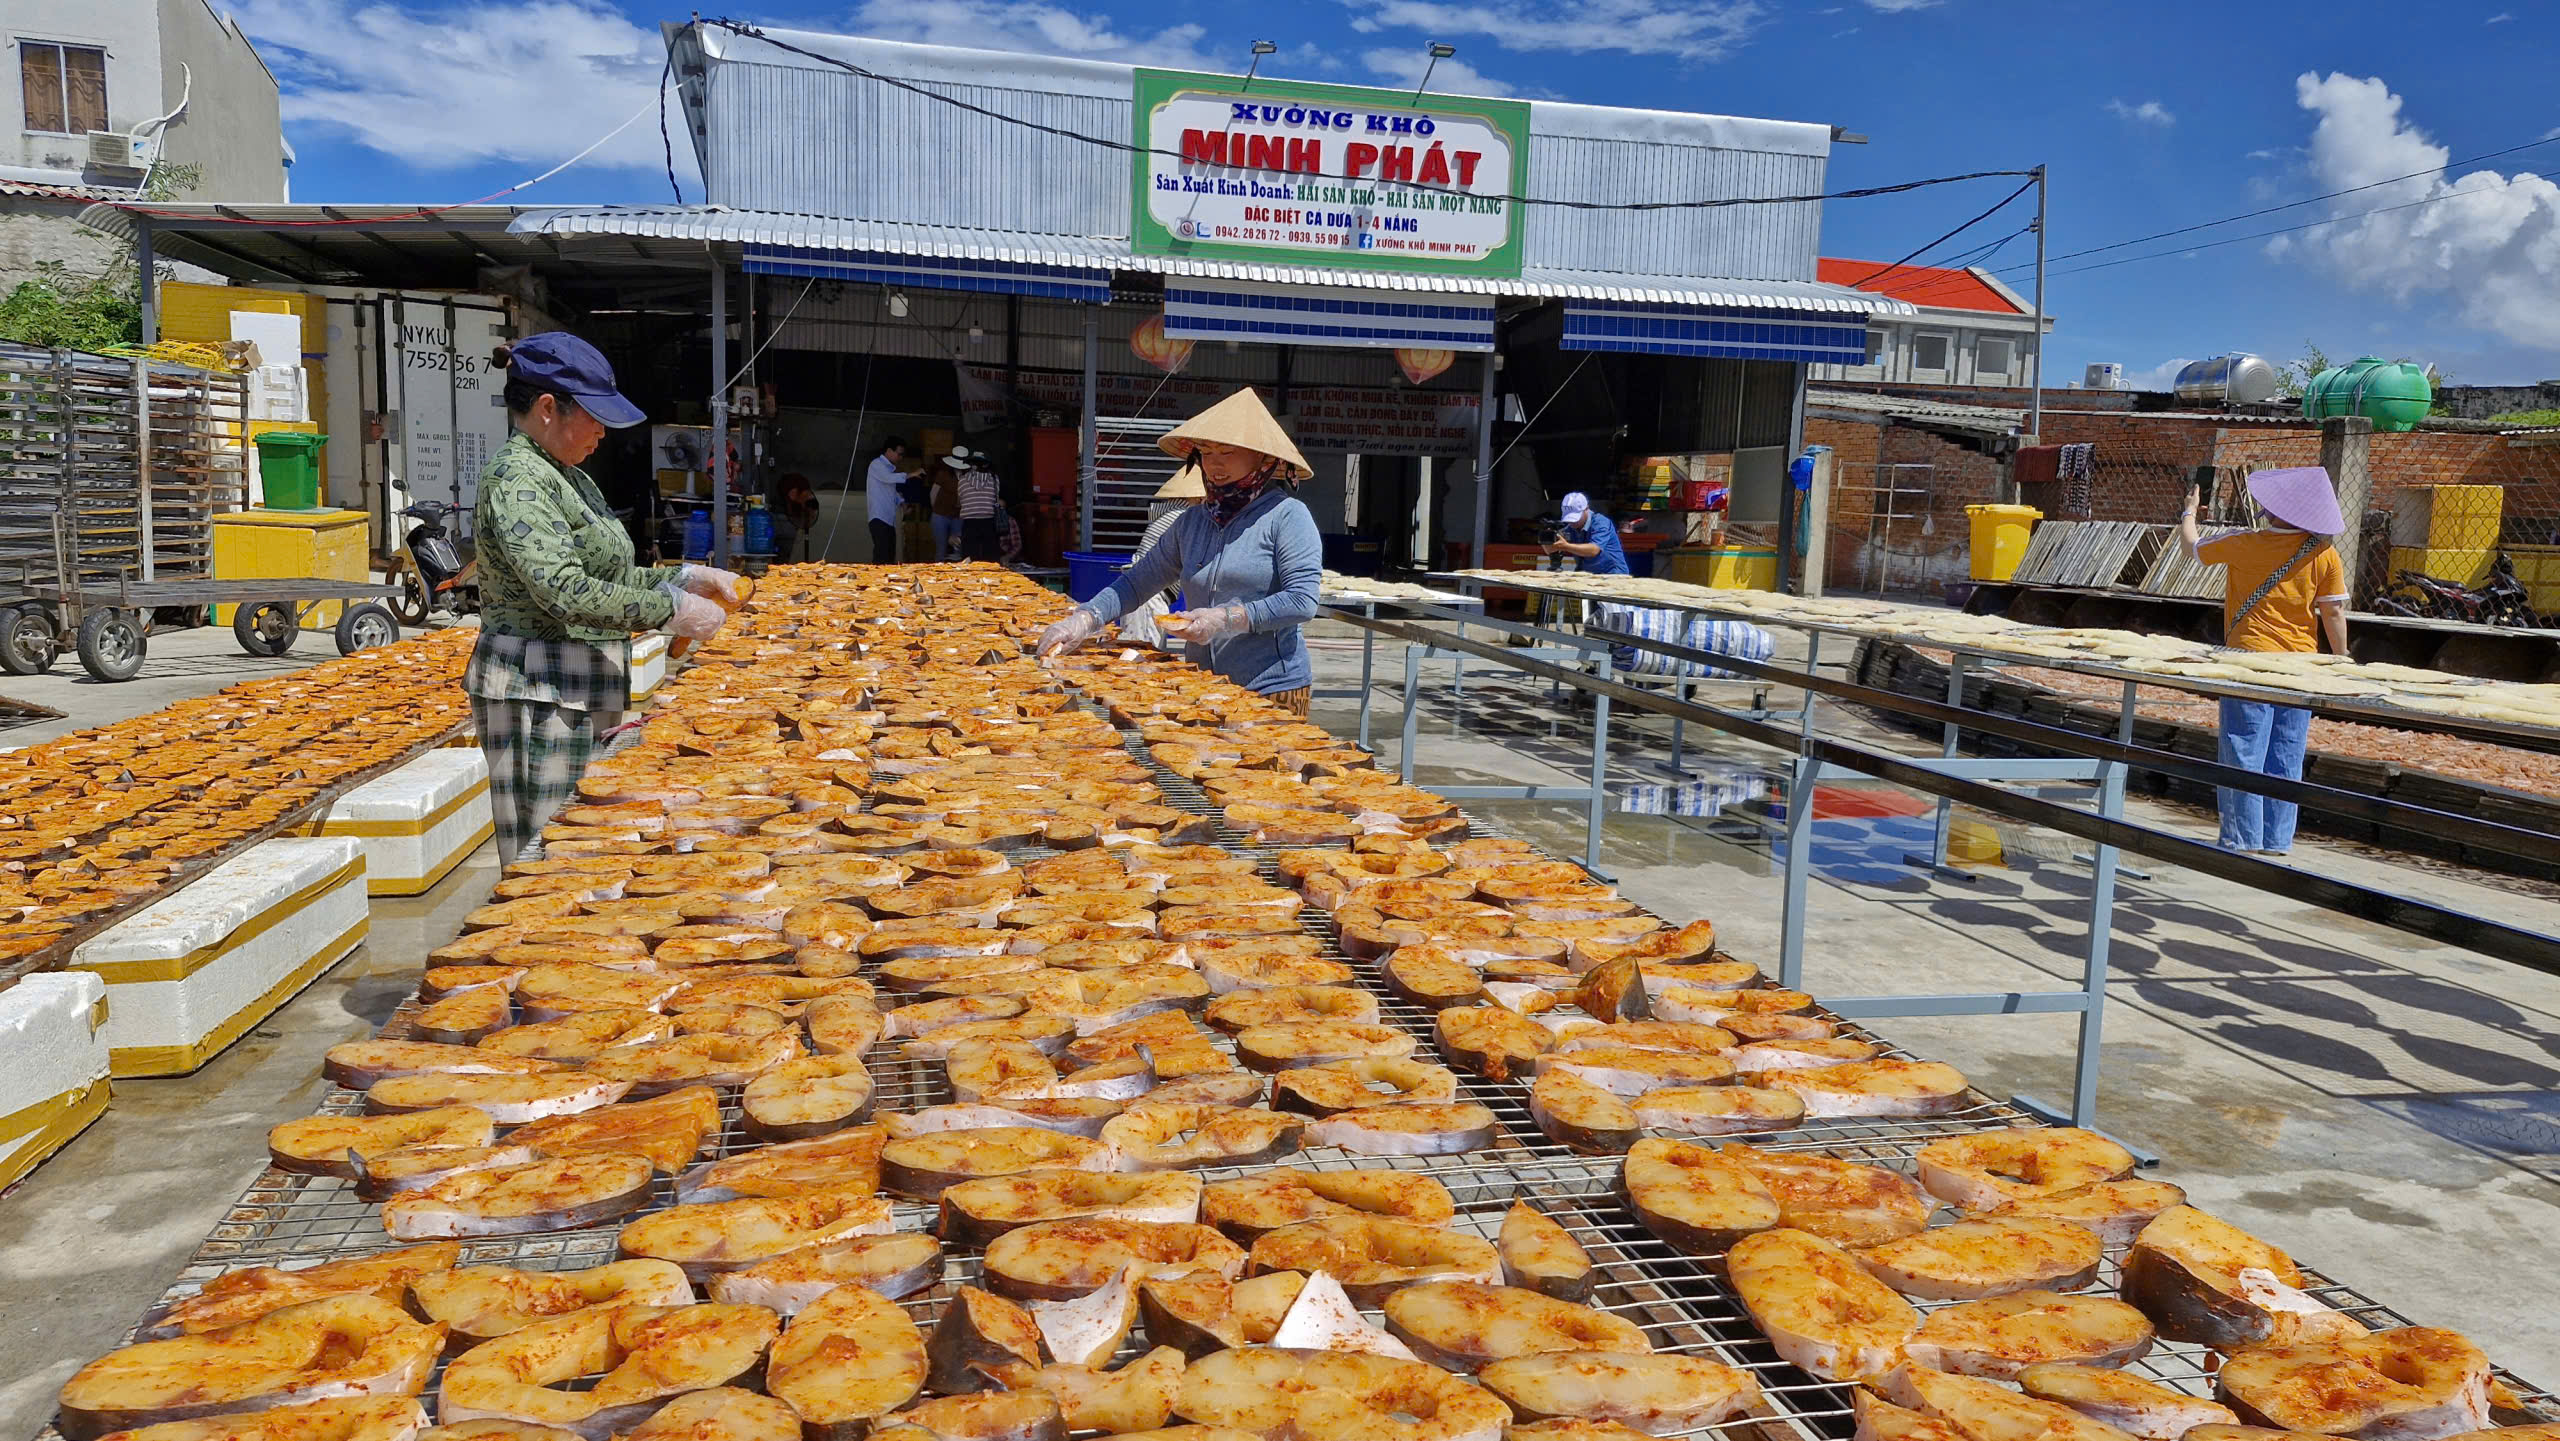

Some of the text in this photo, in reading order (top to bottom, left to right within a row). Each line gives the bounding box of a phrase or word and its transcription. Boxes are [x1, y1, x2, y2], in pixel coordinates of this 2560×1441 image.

[1231, 103, 1436, 135] XƯỞNG KHÔ
[1182, 128, 1482, 186] MINH PHÁT
[1156, 173, 1179, 191] Sản
[1183, 175, 1214, 194] Xuất
[1217, 178, 1247, 196] Kinh
[1250, 181, 1294, 200] Doanh:
[1297, 182, 1319, 202] HẢI
[1323, 183, 1345, 205] SẢN
[1350, 186, 1375, 206] KHÔ
[1244, 206, 1270, 225] ĐẶC
[1273, 207, 1301, 227] BIỆT
[1305, 208, 1322, 226] CÁ
[1384, 213, 1418, 233] NẮNG
[1288, 230, 1313, 244] 0939.
[1315, 232, 1326, 244] 55
[1327, 233, 1339, 245] 99
[1341, 234, 1350, 246] 15
[1375, 234, 1476, 254] XƯỞNG KHÔ MINH PHÁT
[403, 324, 448, 346] NYKU
